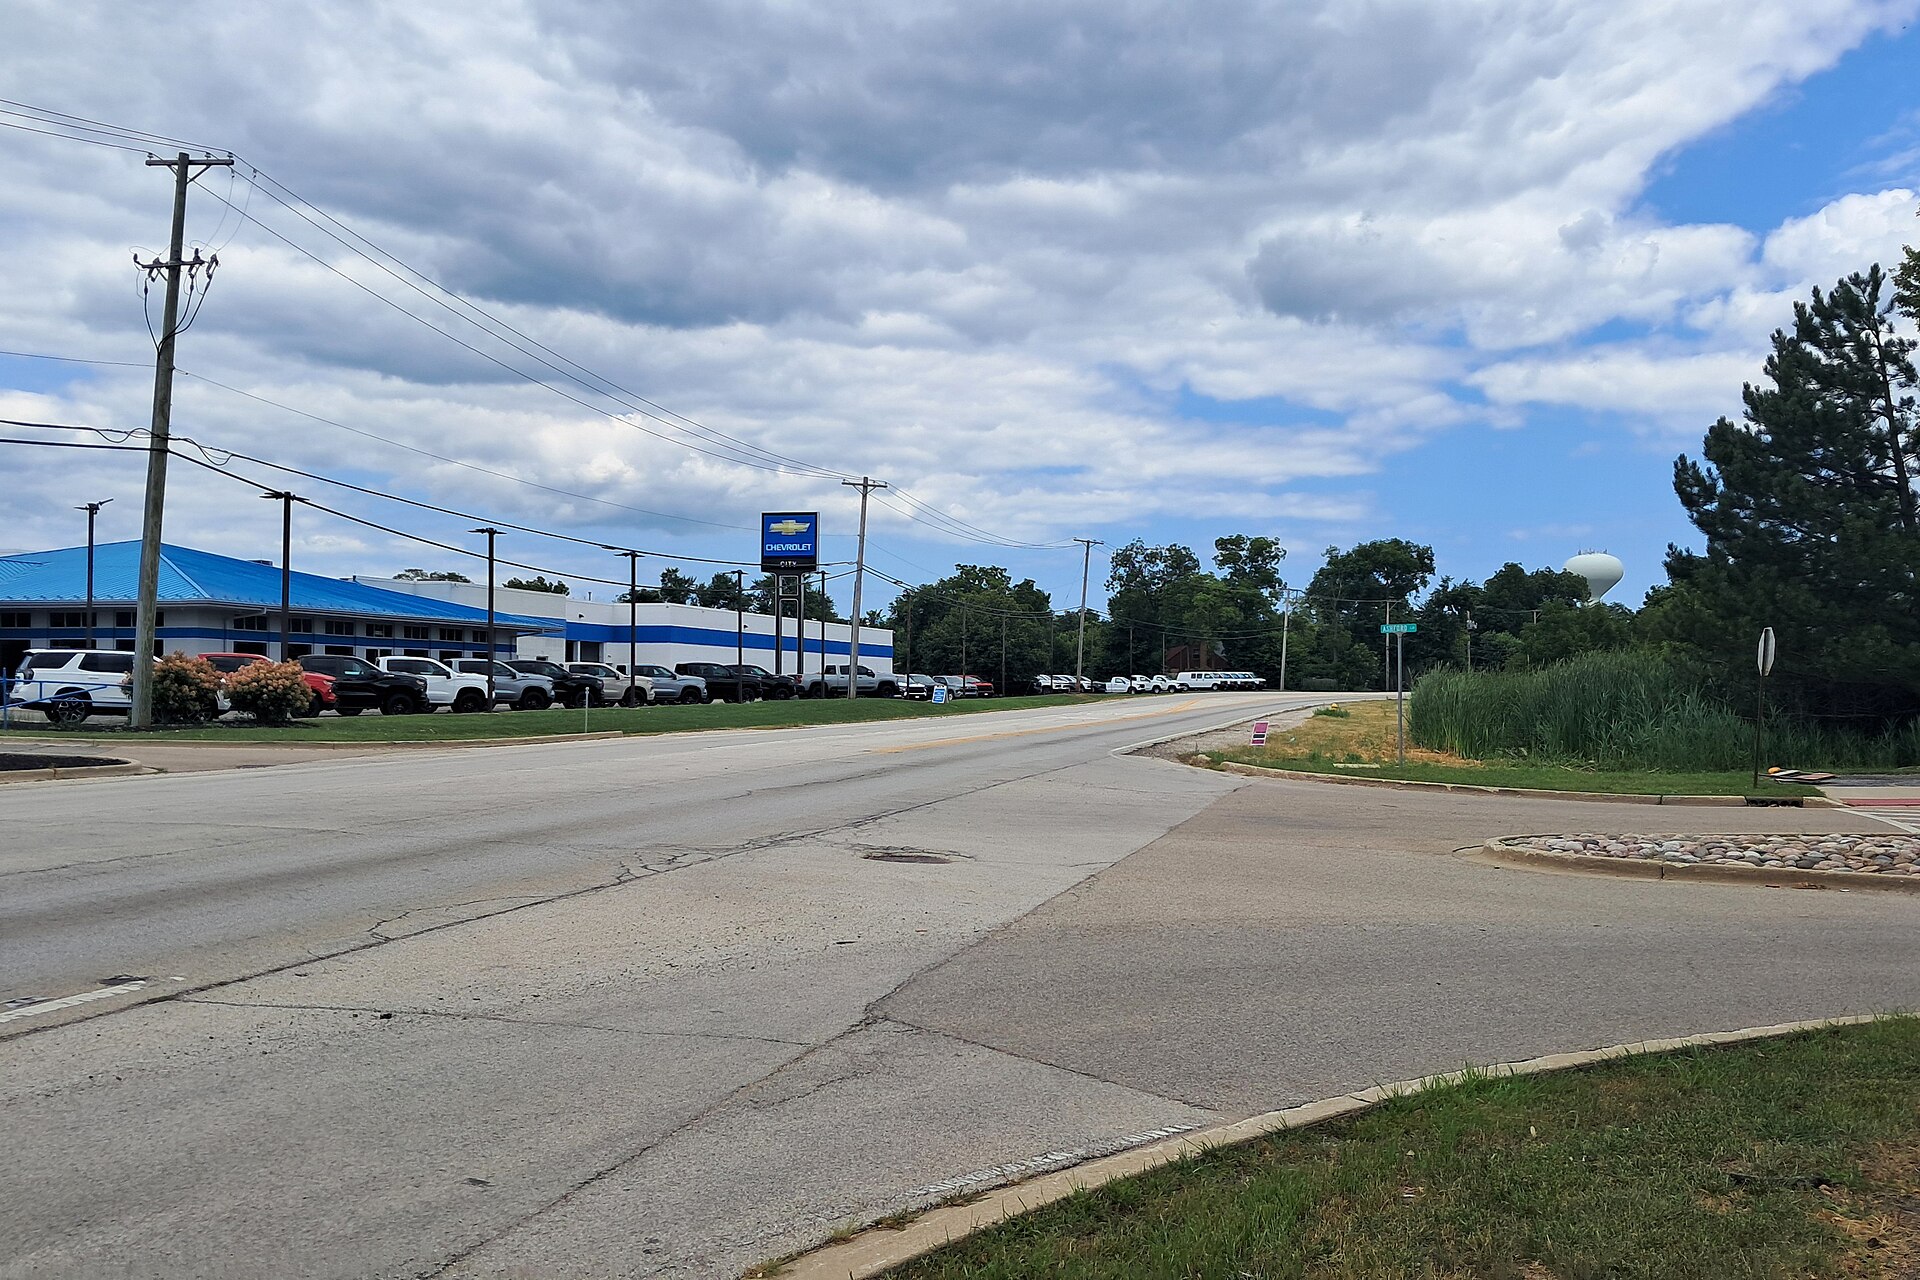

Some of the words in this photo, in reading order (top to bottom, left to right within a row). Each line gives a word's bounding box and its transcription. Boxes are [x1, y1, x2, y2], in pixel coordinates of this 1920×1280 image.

[765, 543, 812, 551] CHEVROLET
[780, 560, 797, 568] CITY
[1382, 624, 1408, 633] ASHFORD
